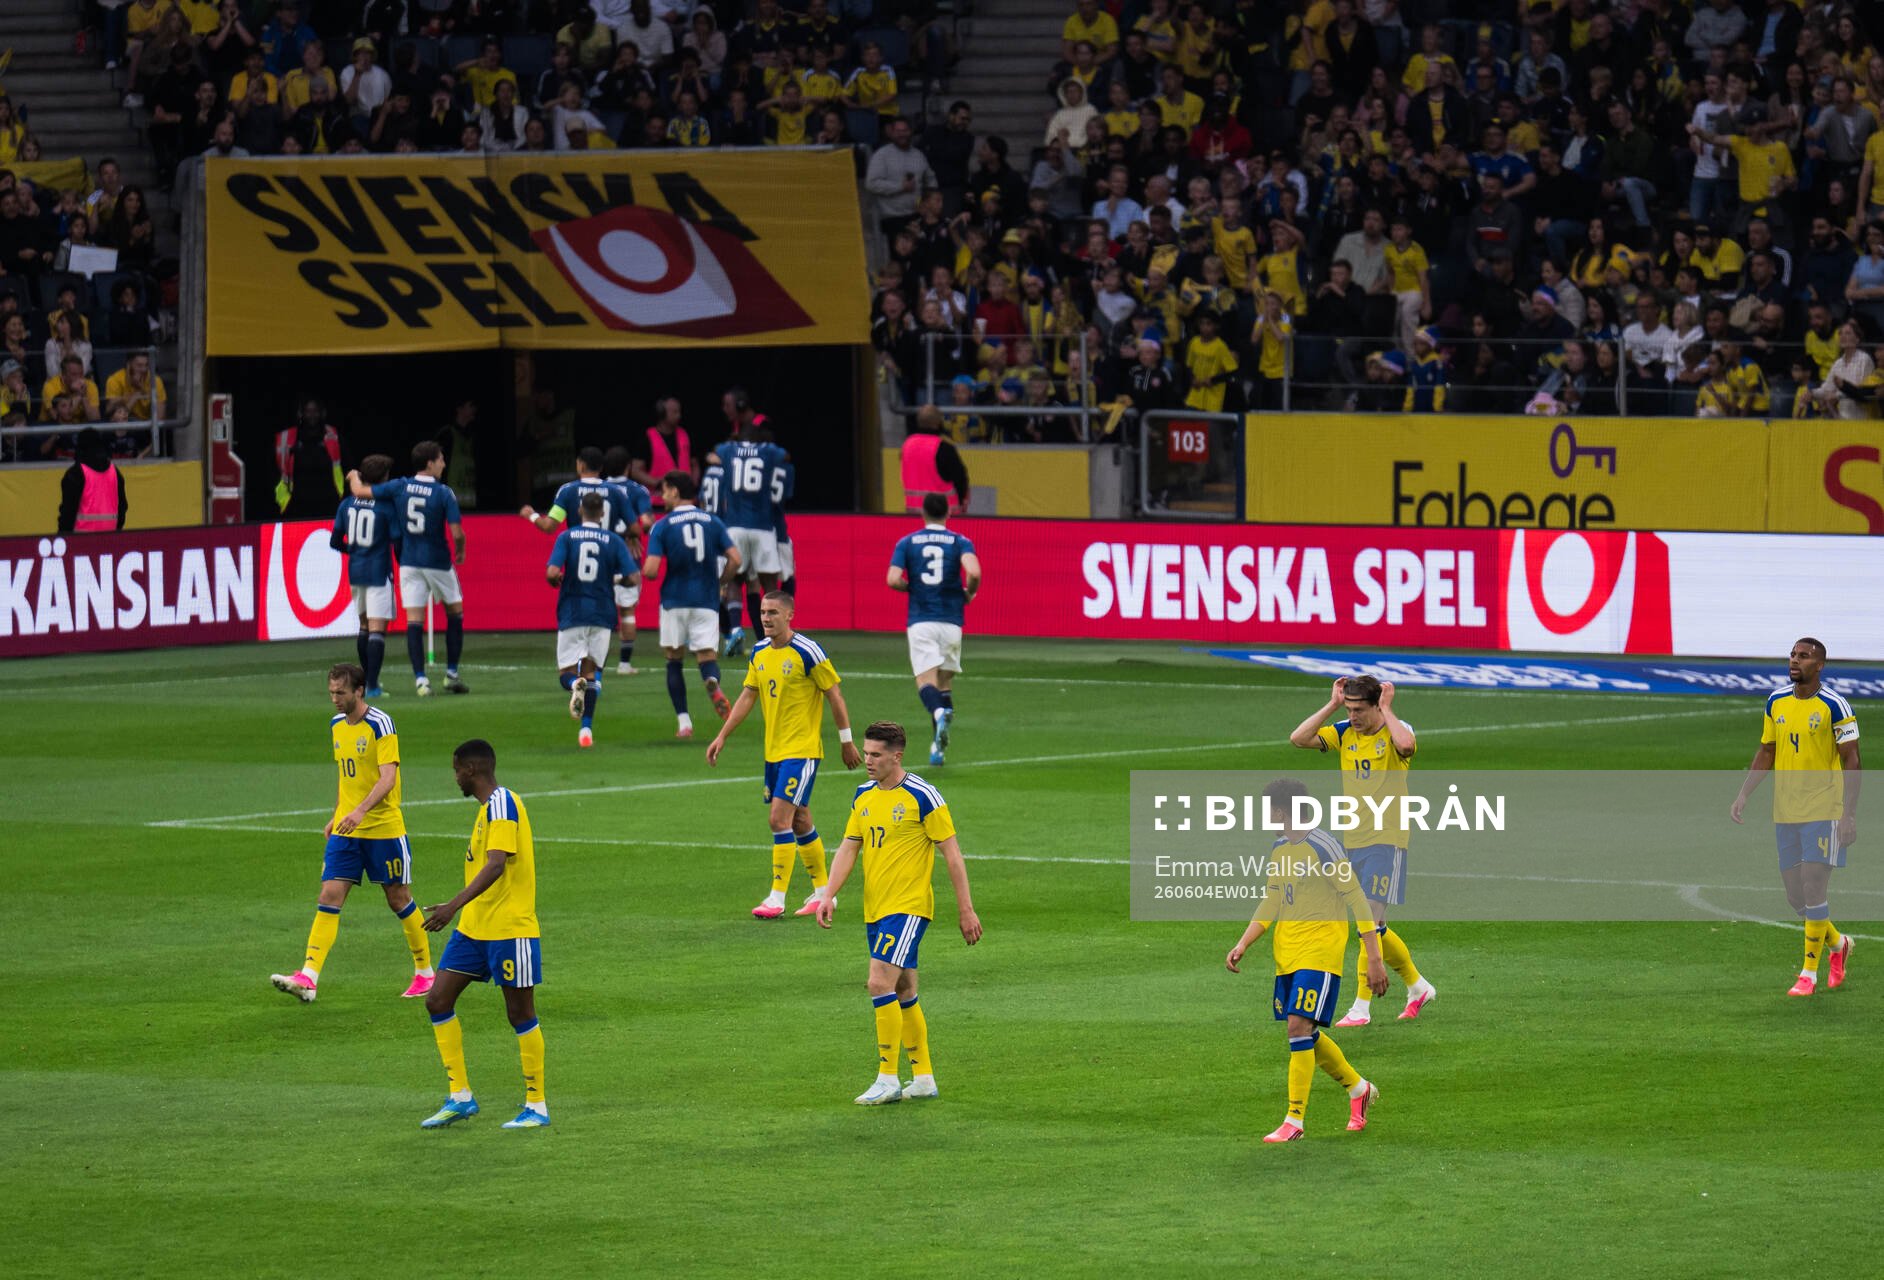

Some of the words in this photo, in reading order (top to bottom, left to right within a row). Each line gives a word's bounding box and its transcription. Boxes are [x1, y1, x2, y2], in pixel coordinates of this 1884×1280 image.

[298, 259, 590, 330] SPEL
[1171, 430, 1205, 453] 103
[731, 457, 765, 492] 16
[702, 476, 720, 513] 21
[347, 507, 376, 548] 10
[406, 496, 426, 534] 5
[681, 522, 706, 563] 4
[577, 541, 600, 583] 6
[921, 545, 945, 585] 3
[0, 537, 255, 637] KÄNSLAN
[1082, 542, 1337, 624] SVENSKA
[1353, 547, 1488, 628] SPEL
[769, 679, 778, 699] 2
[1789, 732, 1800, 753] 4
[341, 758, 357, 778] 10
[1354, 758, 1371, 780] 19
[784, 777, 799, 798] 2
[869, 826, 886, 849] 17
[1817, 836, 1829, 858] 4
[385, 857, 403, 880] 10
[1371, 873, 1390, 898] 19
[873, 931, 896, 956] 17
[502, 959, 515, 982] 9
[1295, 986, 1319, 1014] 18
